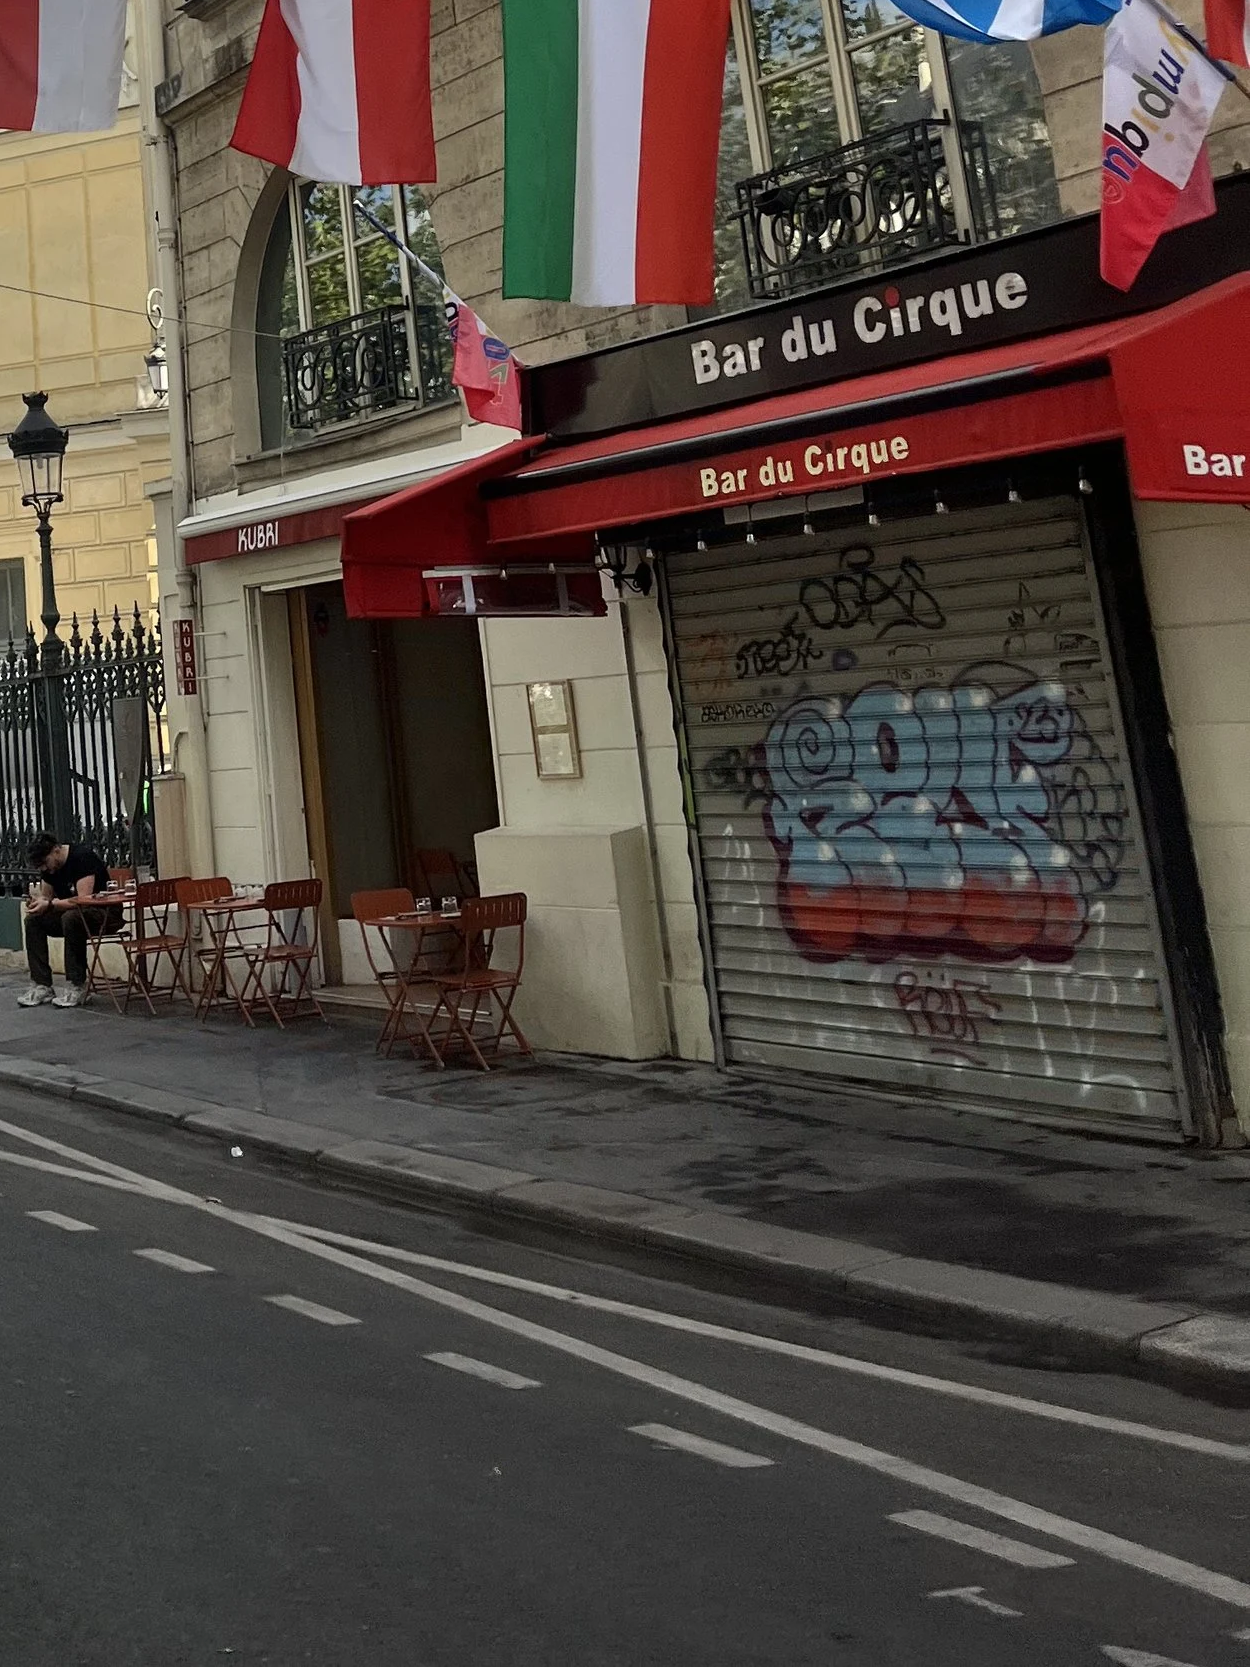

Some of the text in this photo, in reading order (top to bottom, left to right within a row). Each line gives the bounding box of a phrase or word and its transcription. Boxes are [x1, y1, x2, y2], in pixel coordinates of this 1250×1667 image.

[690, 272, 1028, 384] Bar du Cirque
[699, 435, 910, 497] Bar du Cirque
[1182, 444, 1246, 478] Bar
[237, 520, 280, 553] KUBRI
[181, 621, 193, 694] KUBRI
